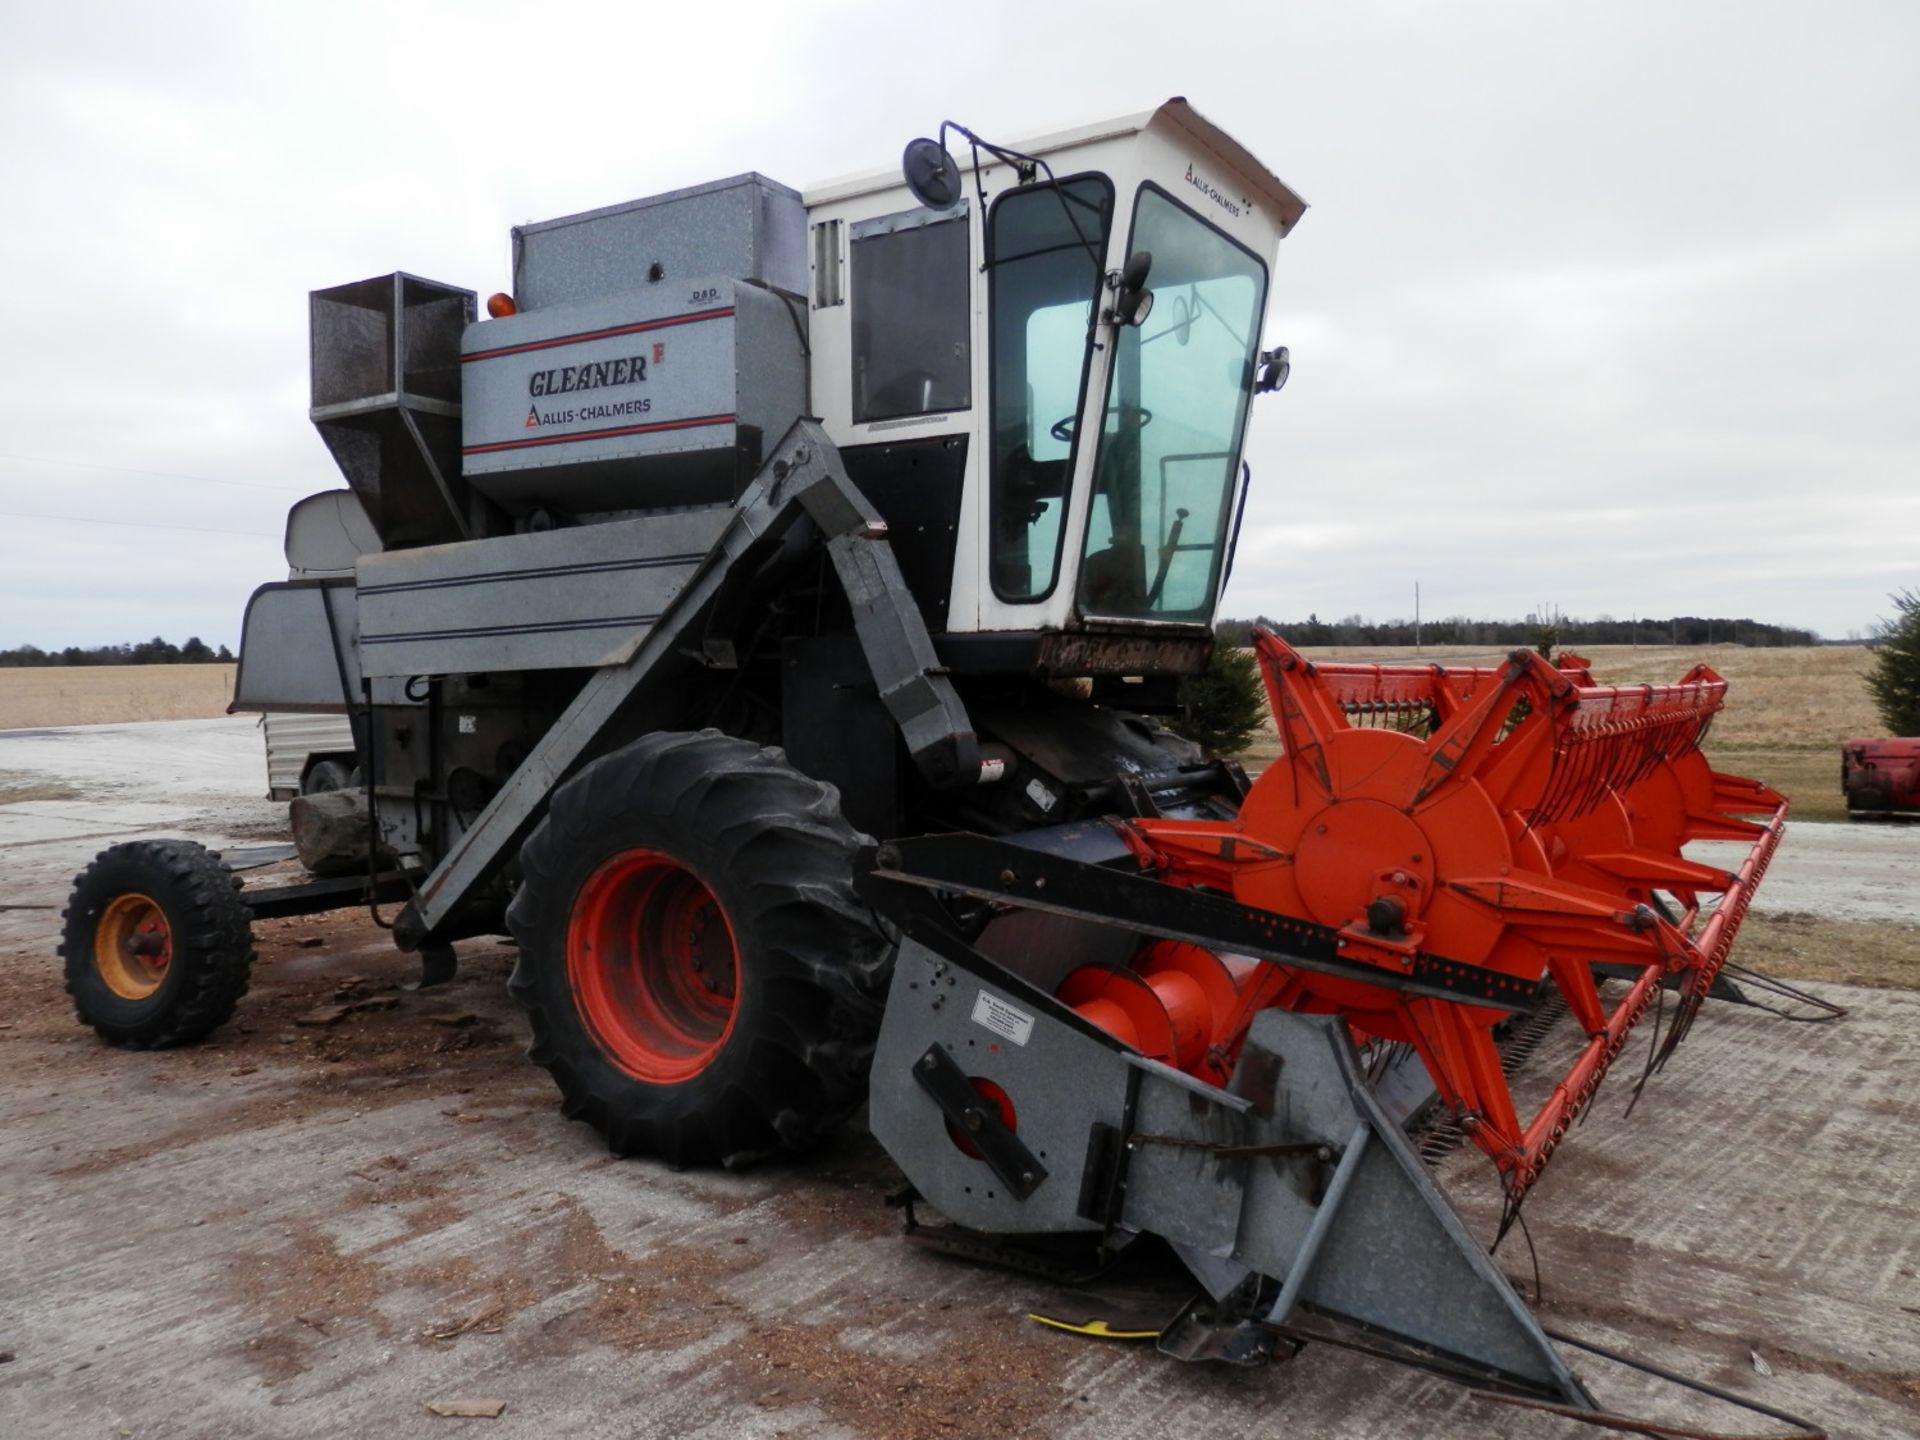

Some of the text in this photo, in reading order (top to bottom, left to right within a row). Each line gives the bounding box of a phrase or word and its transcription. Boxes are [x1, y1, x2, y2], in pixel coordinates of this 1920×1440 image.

[529, 342, 665, 398] GLEANER F
[542, 398, 651, 426] ALLIS-CHALMERS
